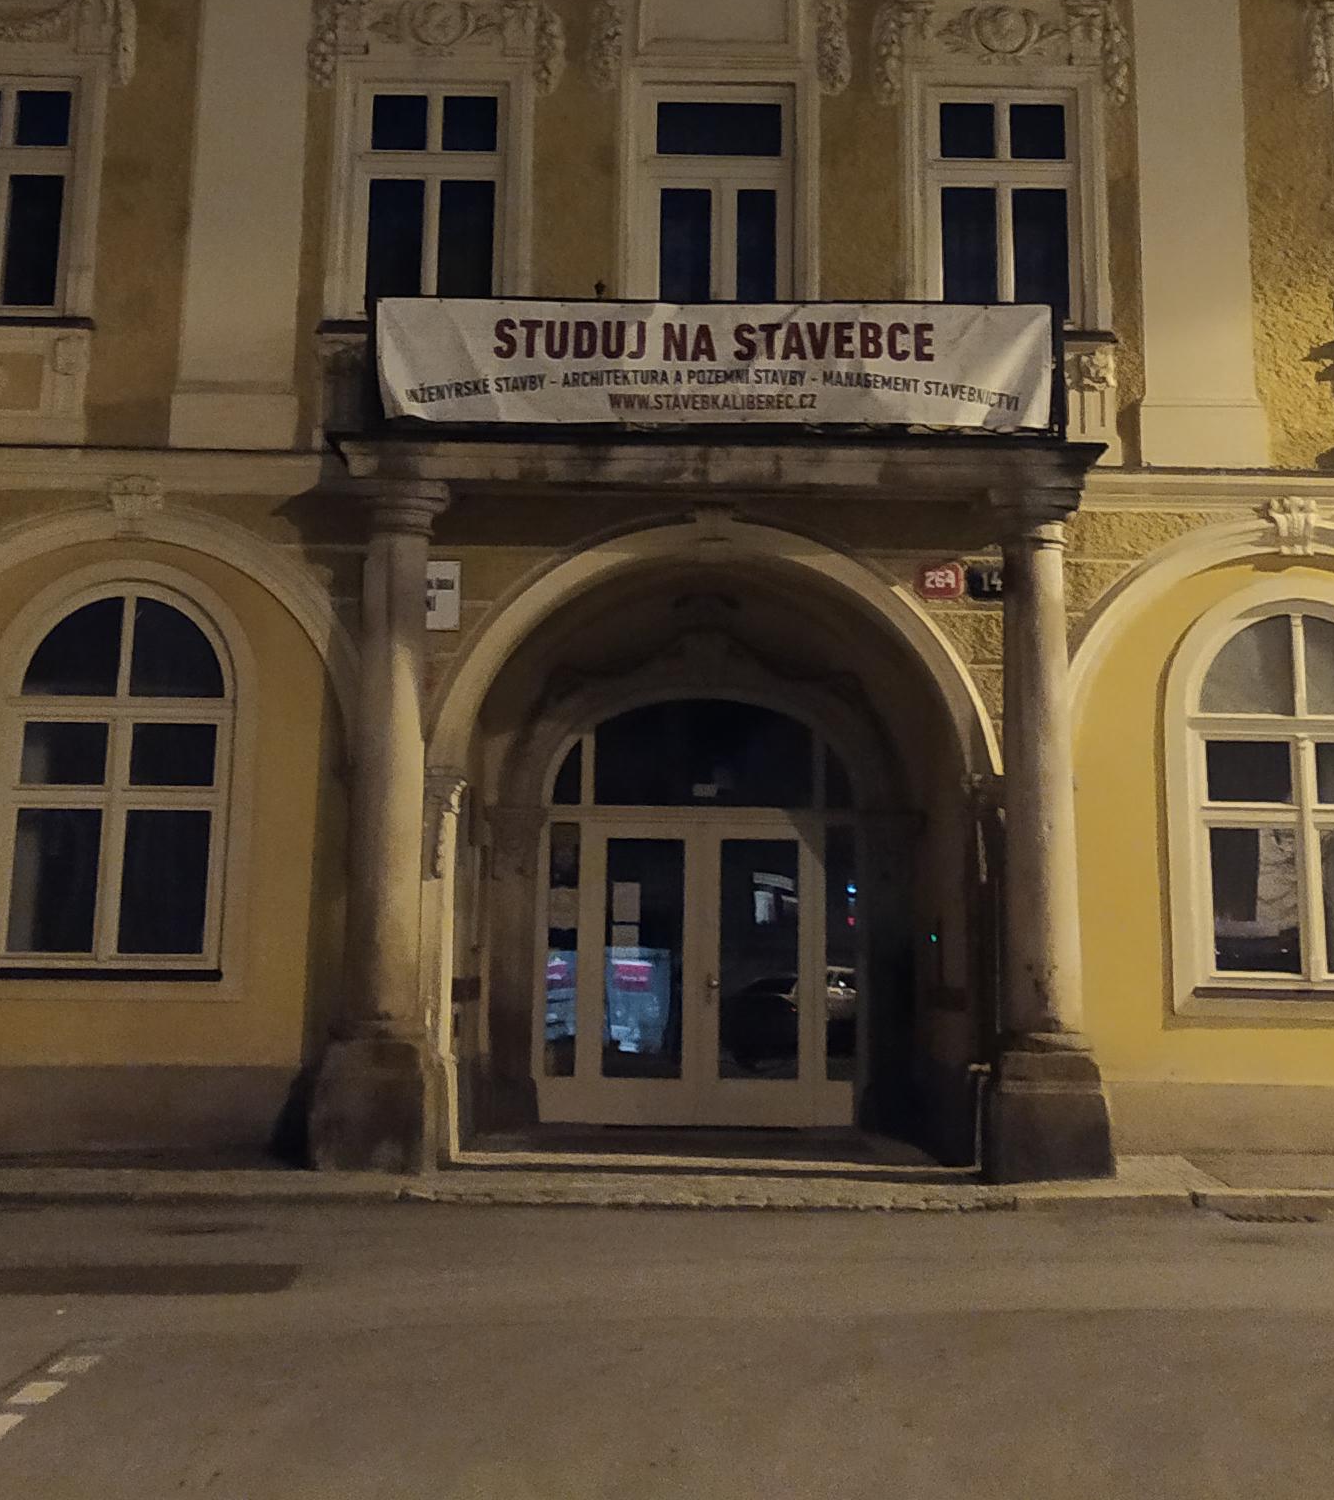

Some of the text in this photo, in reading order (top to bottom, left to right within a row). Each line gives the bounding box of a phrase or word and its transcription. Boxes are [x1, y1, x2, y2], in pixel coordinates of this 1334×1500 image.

[493, 318, 935, 362] STUDUJ NA STAVEBCE
[494, 373, 546, 393] STAVBY
[562, 369, 667, 388] ARCHITEKTURA
[674, 370, 682, 385] A
[754, 369, 806, 387] STAVBY
[822, 370, 919, 394] MANAGEMENT
[982, 571, 1003, 591] 14
